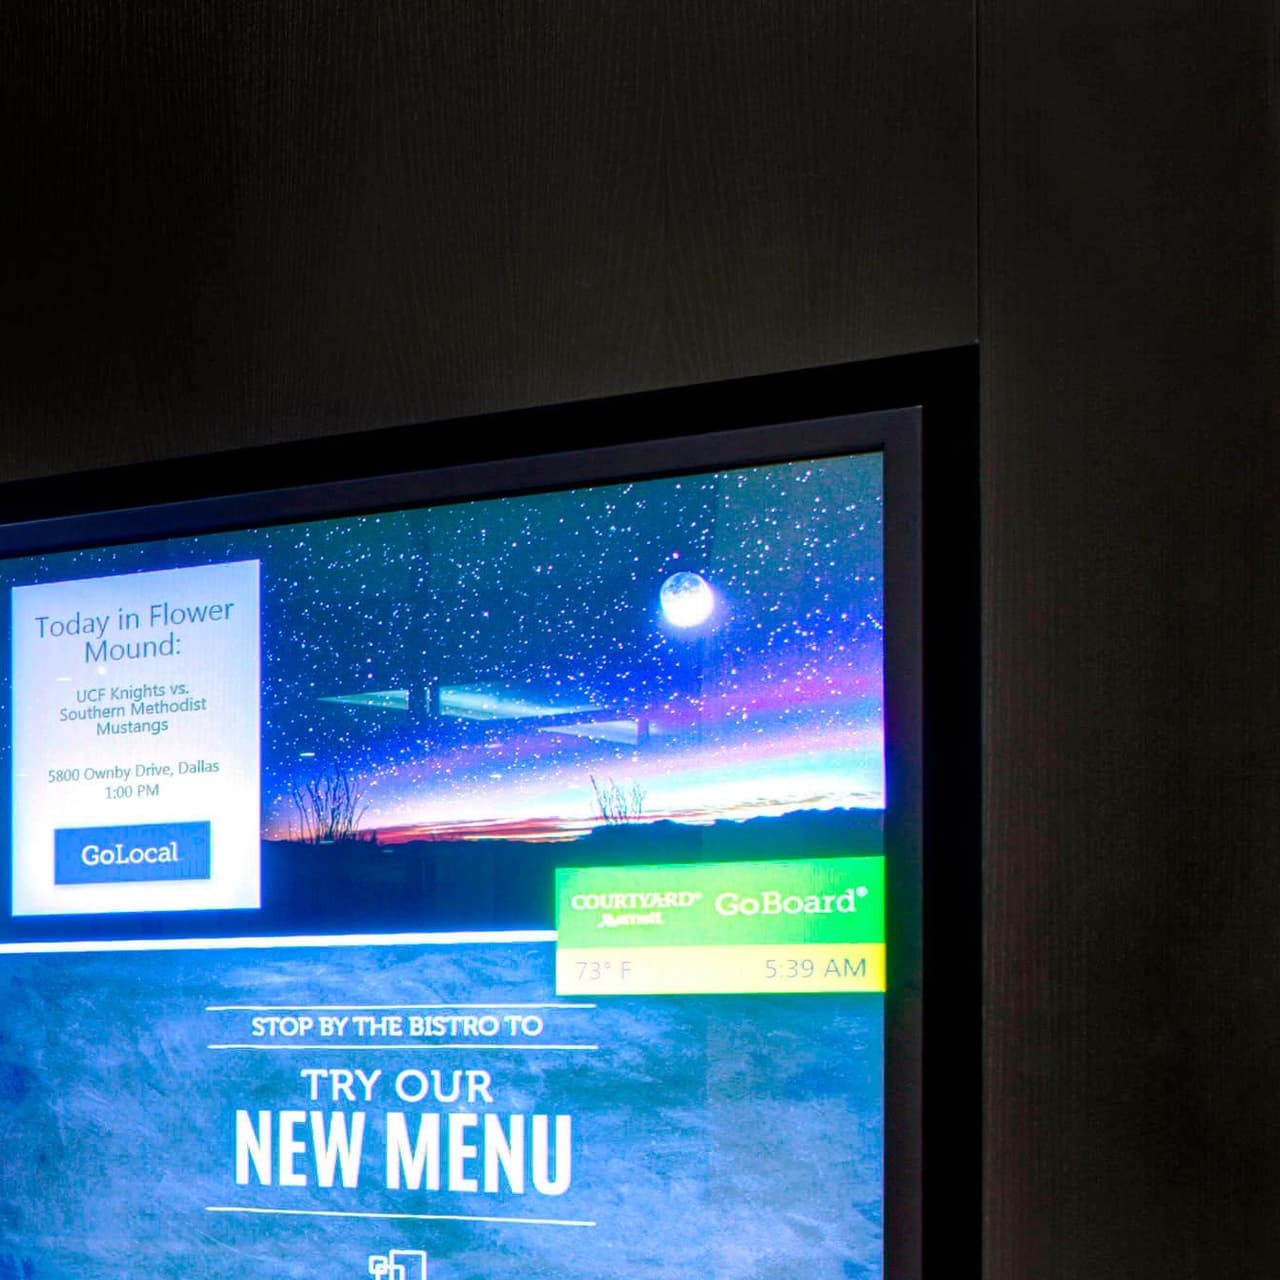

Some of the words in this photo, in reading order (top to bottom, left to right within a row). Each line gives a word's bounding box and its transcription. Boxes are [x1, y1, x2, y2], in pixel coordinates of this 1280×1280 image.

[35, 612, 109, 639] Today
[118, 608, 140, 630] in
[150, 601, 234, 628] Flower
[85, 631, 182, 663] Mound:
[76, 688, 106, 703] UCF
[110, 683, 165, 702] Knights
[170, 683, 189, 695] vs.
[59, 704, 125, 722] Southern
[130, 697, 207, 716] Methodist
[96, 718, 169, 736] Mustangs
[48, 768, 80, 783] 5800
[84, 764, 131, 782] Ownby
[135, 761, 174, 778] Drive,
[178, 760, 220, 775] Dallas
[104, 785, 133, 800] 1:00
[137, 784, 160, 798] PM
[81, 841, 179, 866] GoLocal
[576, 961, 611, 981] 73°
[621, 961, 632, 979] F
[764, 959, 814, 979] 5:39
[824, 958, 866, 977] AM
[251, 1016, 313, 1037] STOP
[319, 1016, 348, 1037] BY
[351, 1015, 402, 1037] THE
[409, 1015, 499, 1037] BISTRO
[504, 1015, 544, 1036] TO
[300, 1068, 382, 1102] TRY
[395, 1069, 493, 1103] OUR
[236, 1109, 366, 1188] NEW
[385, 1111, 572, 1195] MENU
